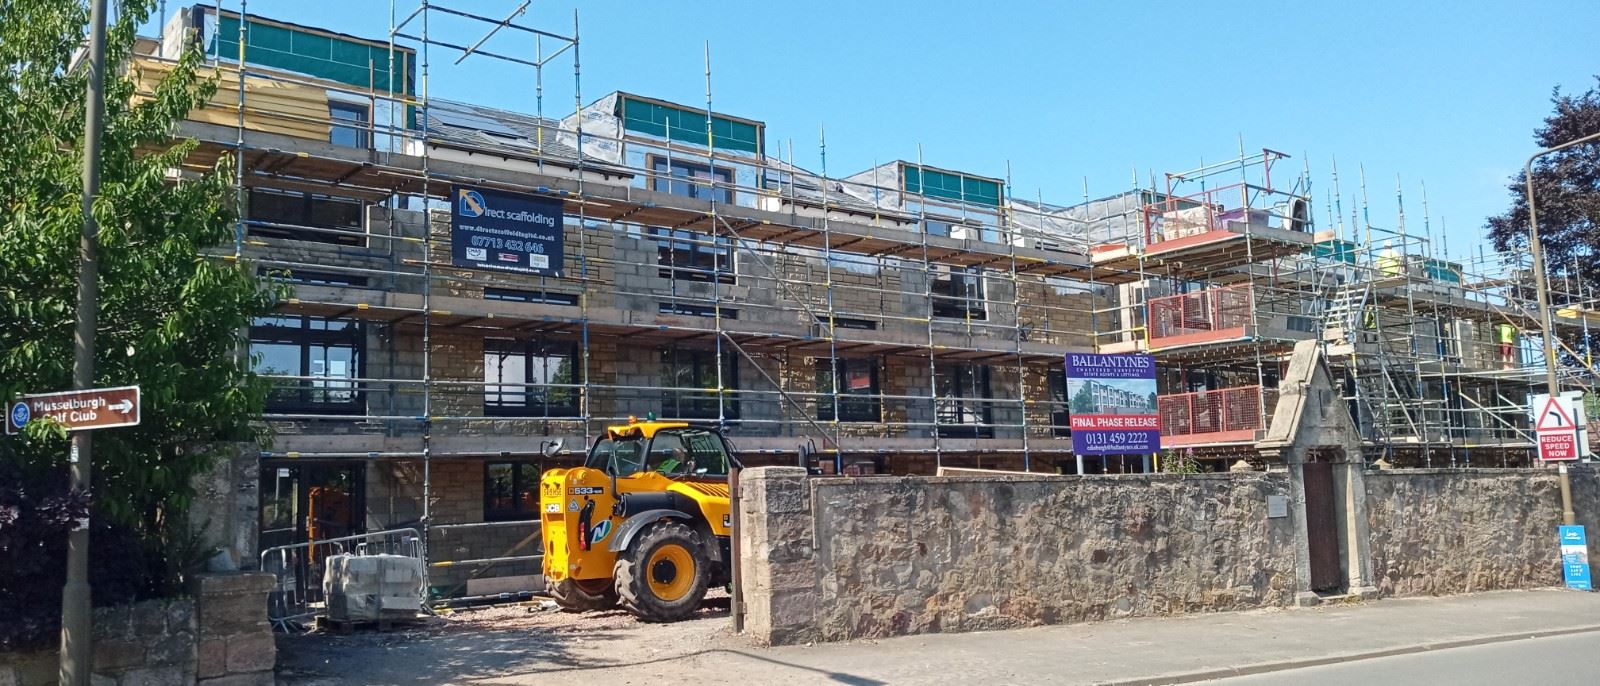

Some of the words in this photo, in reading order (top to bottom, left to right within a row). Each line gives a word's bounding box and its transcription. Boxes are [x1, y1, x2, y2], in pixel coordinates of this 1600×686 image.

[507, 211, 554, 227] scaffolding
[472, 236, 503, 249] 07713
[504, 240, 524, 252] 432
[525, 242, 544, 254] 646
[1072, 355, 1150, 368] BALLANTYNES
[34, 397, 106, 412] Musselburgh
[70, 410, 97, 422] Club
[1072, 418, 1096, 427] FINAL
[1098, 418, 1124, 427] PHASE
[1124, 418, 1158, 427] RELEASE
[1086, 433, 1107, 444] 0131
[1110, 433, 1126, 444] 459
[1128, 432, 1148, 444] 2222
[546, 504, 560, 512] JCB
